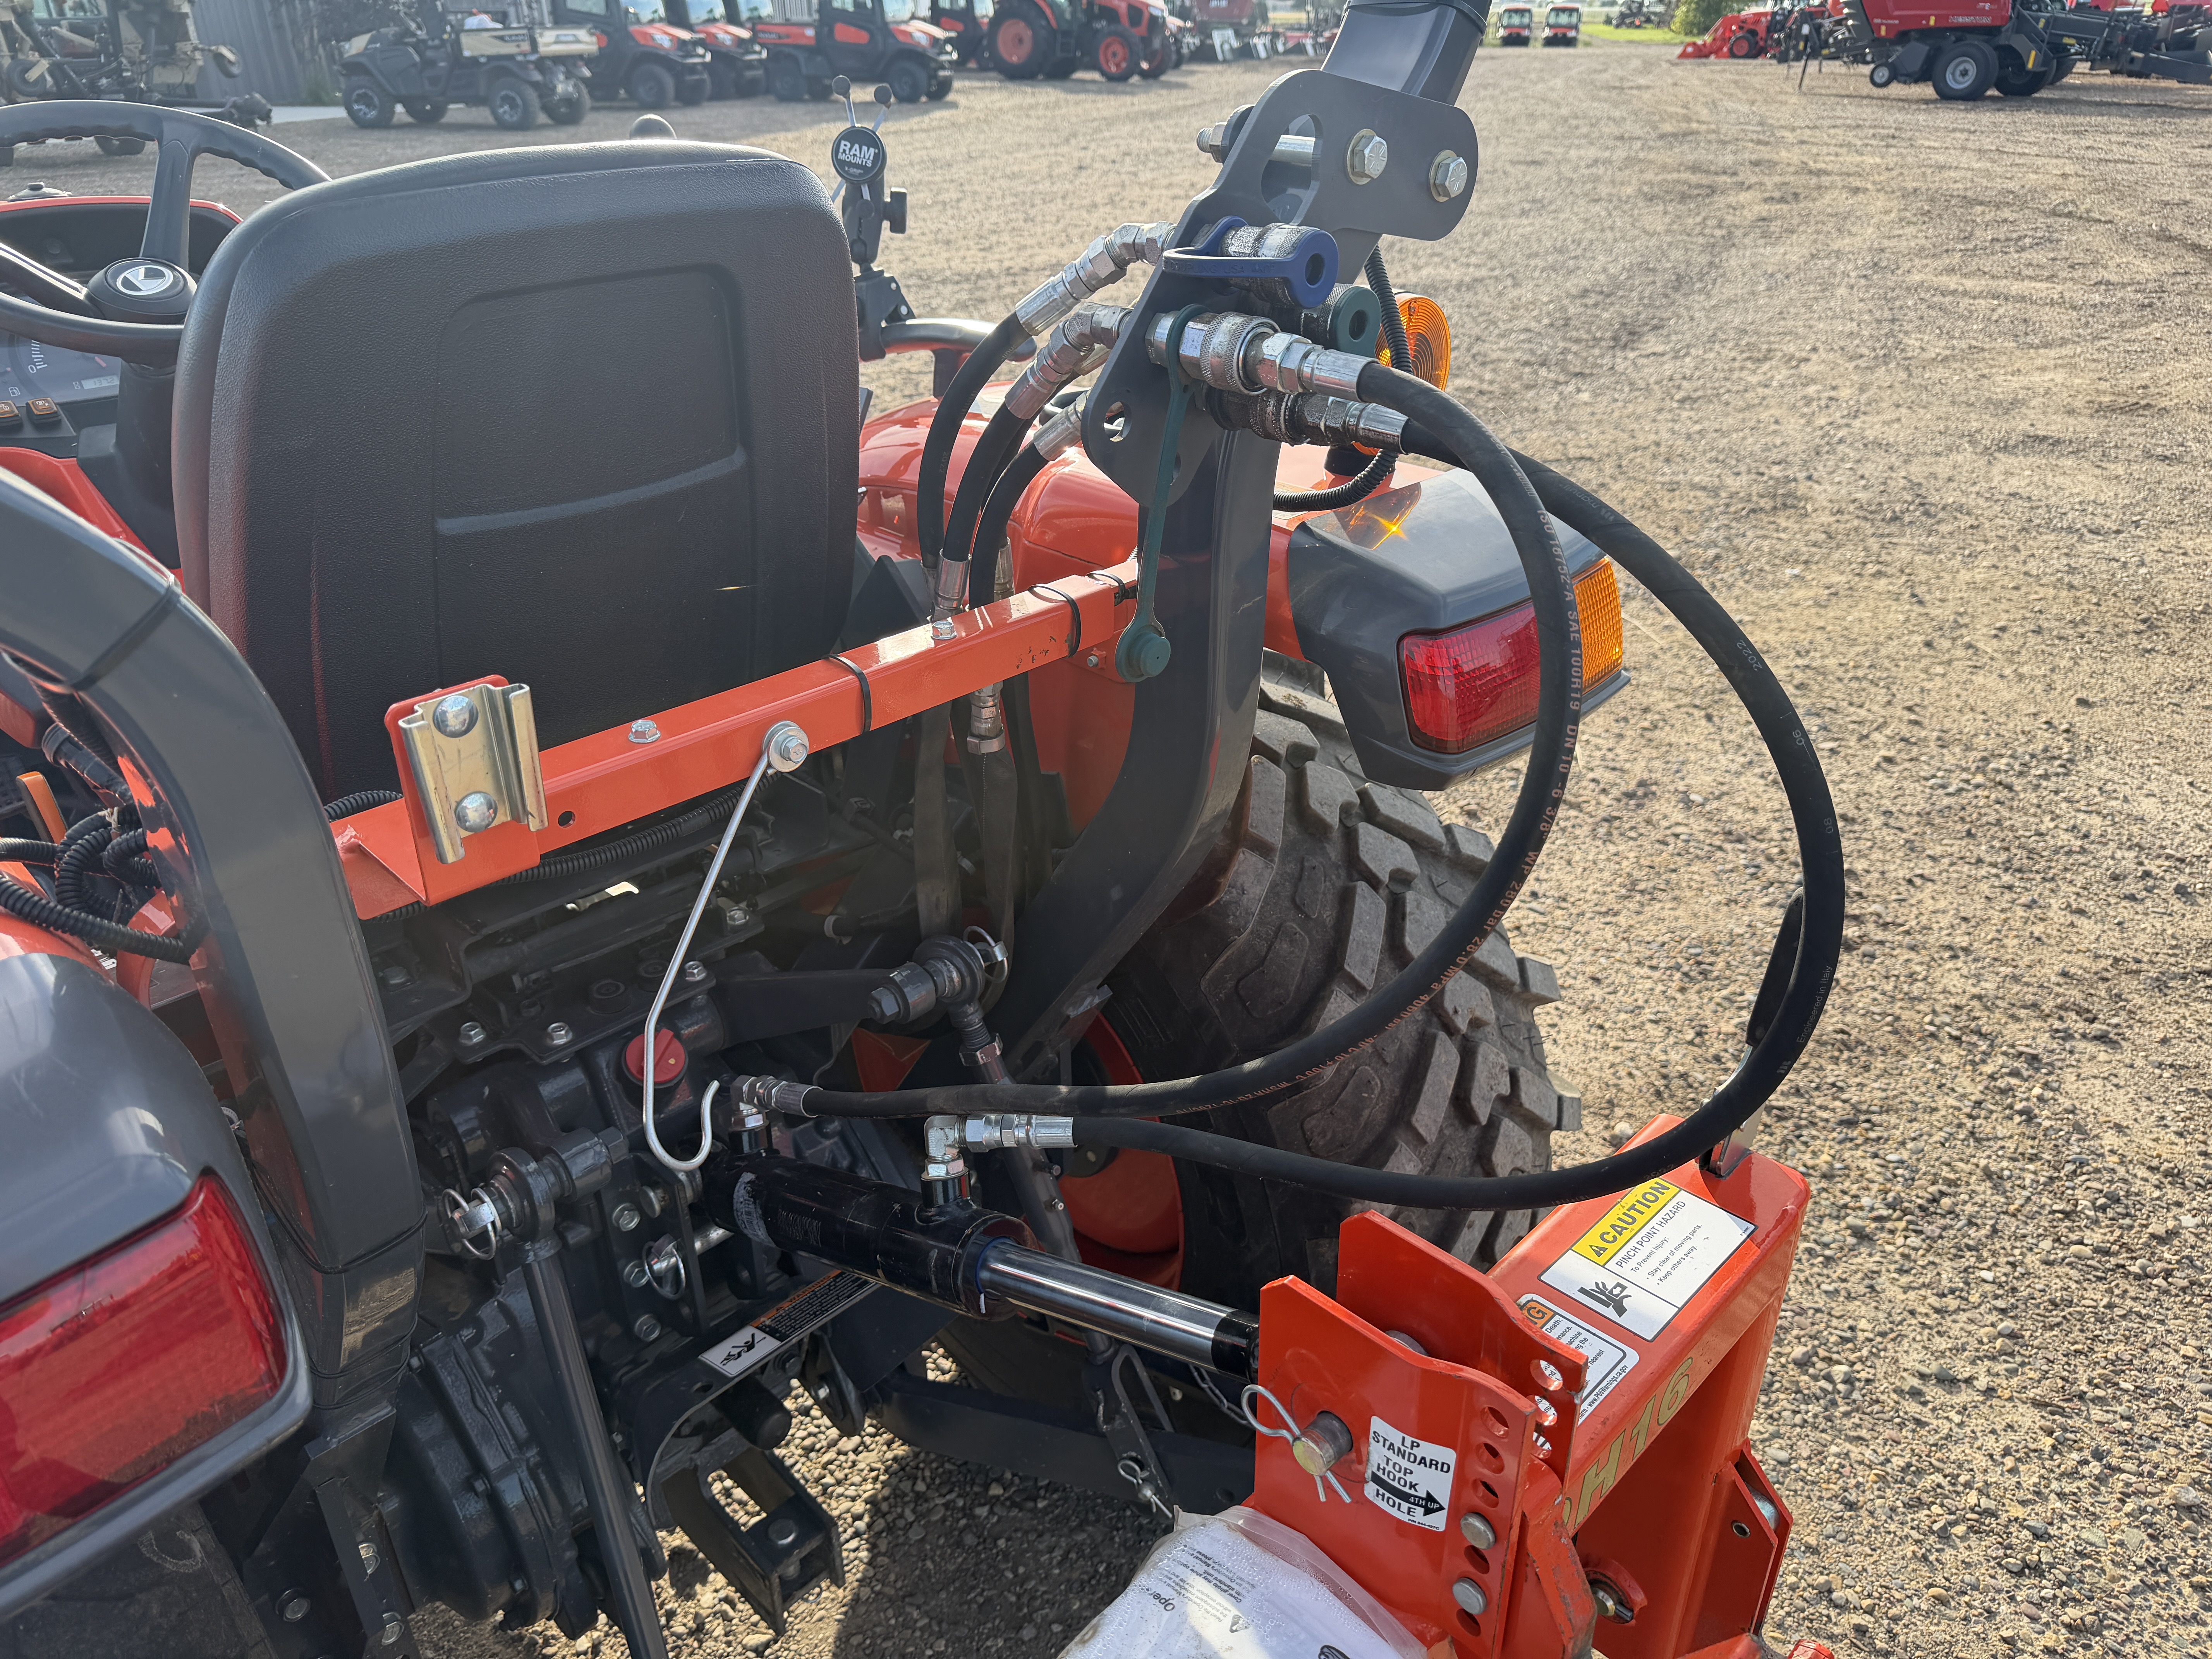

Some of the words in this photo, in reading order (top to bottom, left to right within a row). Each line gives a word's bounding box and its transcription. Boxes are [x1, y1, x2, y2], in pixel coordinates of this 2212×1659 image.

[838, 152, 872, 167] MOUNTS
[839, 140, 875, 160] RAM
[1537, 510, 1554, 532] ISO
[1548, 539, 1573, 602] 18752-A
[1567, 610, 1580, 642] SAE
[1736, 639, 1763, 672] 2022
[1568, 645, 1582, 709] 100R19
[1565, 724, 1576, 748] DN
[1559, 755, 1573, 773] 10
[1521, 851, 1539, 874] WP
[1499, 880, 1523, 907] 280
[1483, 908, 1504, 933] bar
[1458, 936, 1484, 966] 28.0
[1430, 964, 1460, 991] MPa
[1820, 965, 1833, 984] Italy
[1816, 986, 1827, 995] in
[1796, 996, 1823, 1044] Engineered
[1599, 1181, 1670, 1244] CAUTION
[1615, 1245, 1641, 1268] PINCH
[1637, 1226, 1661, 1248] POINT
[1657, 1199, 1686, 1228] HAZARD
[1637, 1249, 1656, 1267] Prevent
[1653, 1236, 1669, 1252] Injury:
[1647, 1266, 1661, 1277] Stay
[1657, 1255, 1671, 1267] clear
[1673, 1235, 1692, 1252] moving
[1689, 1223, 1702, 1237] parts.
[1658, 1269, 1673, 1282] Keep
[1669, 1255, 1686, 1271] others
[1683, 1244, 1697, 1258] away.
[1546, 1317, 1563, 1334] Death:
[1556, 1326, 1573, 1341] enance.
[1579, 1337, 1588, 1345] the
[1588, 1350, 1604, 1365] nearest
[1586, 1364, 1628, 1407] www.P65Warnings.ca.gov
[1372, 1431, 1450, 1473] STANDARD
[1401, 1436, 1420, 1451] LP
[1384, 1455, 1413, 1476] TOP
[1377, 1463, 1419, 1492] HOOK
[1376, 1488, 1417, 1517] HOLE
[1409, 1496, 1425, 1506] 4TH
[1193, 1554, 1212, 1568] Manual
[1196, 1549, 1212, 1562] please
[1164, 1574, 1173, 1582] and
[1170, 1571, 1179, 1579] and
[1189, 1567, 1202, 1578] show
[1201, 1573, 1214, 1584] may
[1202, 1569, 1214, 1578] unit.
[1165, 1582, 1182, 1596] Manual
[1212, 1575, 1235, 1592] standard
[1212, 1580, 1229, 1594] photo
[1194, 1594, 1221, 1613] subsequent
[1226, 1590, 1242, 1603] Cover
[1215, 1601, 1232, 1614] without
